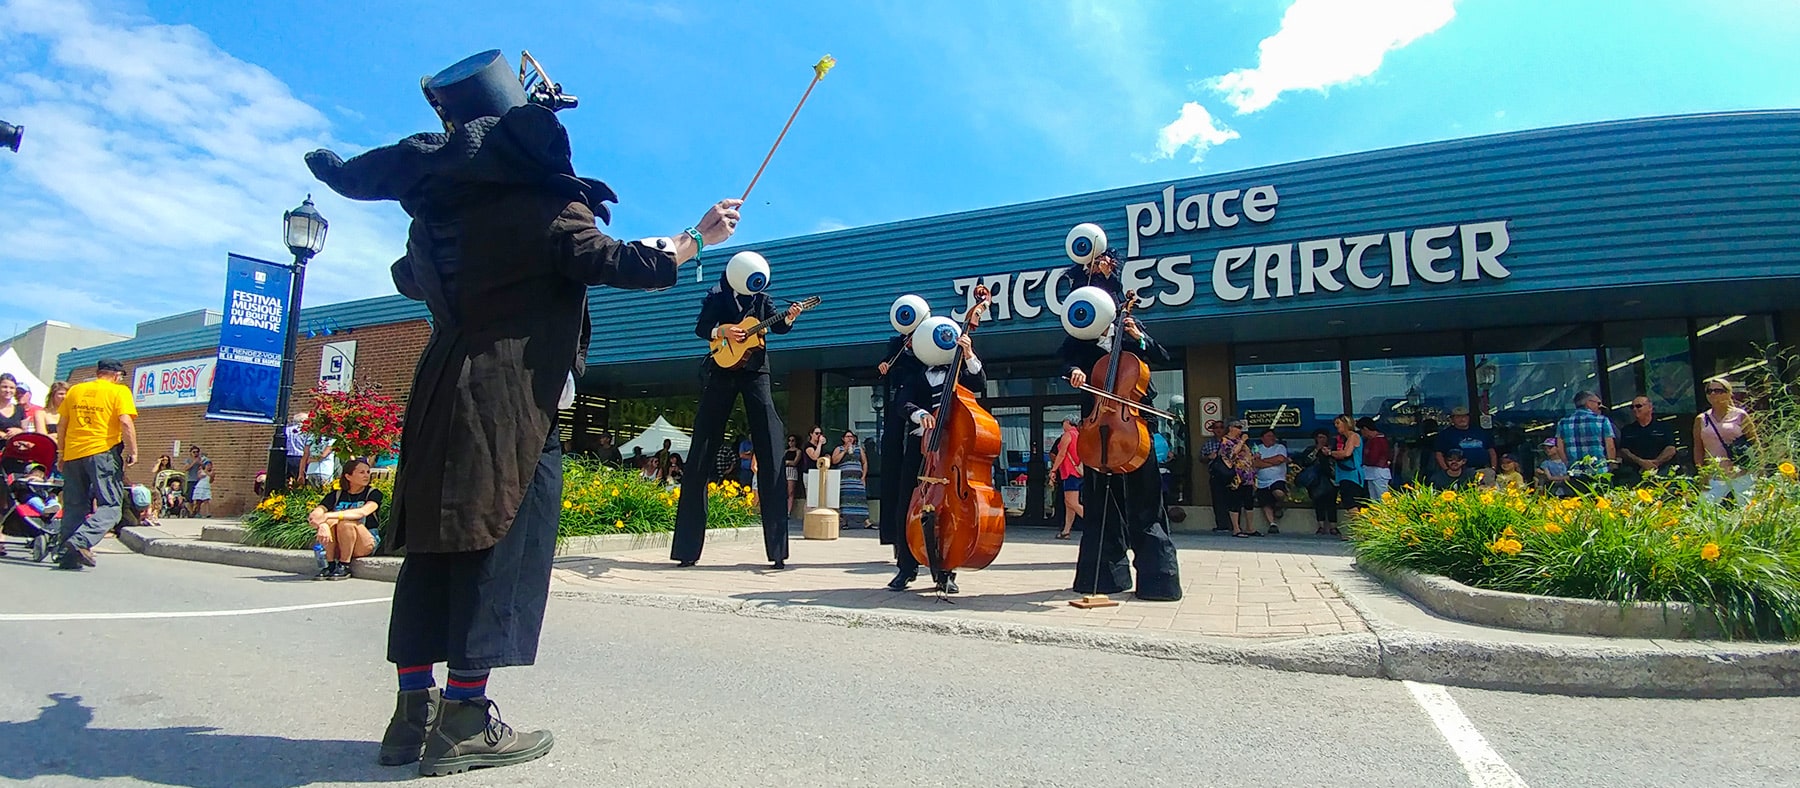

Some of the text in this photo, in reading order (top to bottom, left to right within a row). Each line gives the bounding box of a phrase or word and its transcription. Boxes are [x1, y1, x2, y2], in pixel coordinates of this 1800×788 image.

[1126, 184, 1279, 258] place
[950, 220, 1511, 323] JACES CARTIER
[233, 290, 283, 308] FESTIVAL
[230, 308, 281, 324] DU BOUT DU
[231, 300, 283, 317] MUSIQUE
[230, 315, 281, 334] MONDE
[220, 345, 281, 361] LE RENDEZ-VOUS
[159, 365, 204, 394] ROSSY
